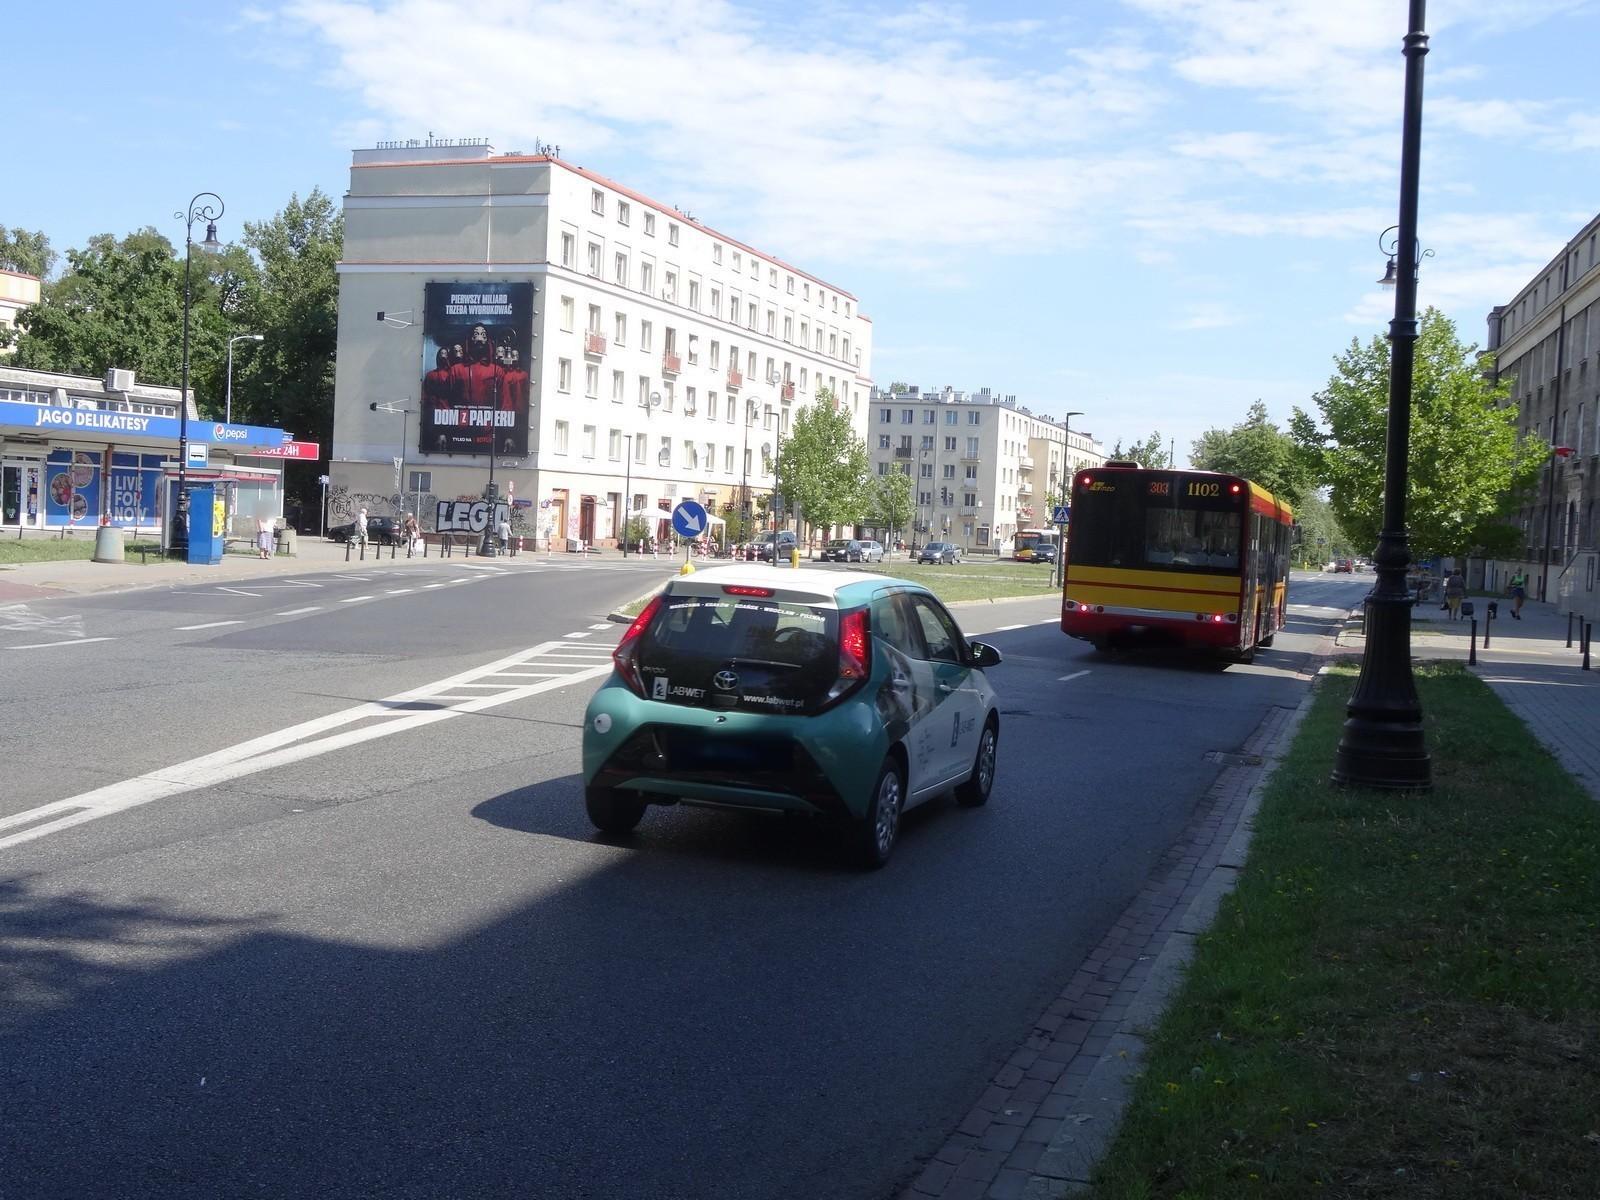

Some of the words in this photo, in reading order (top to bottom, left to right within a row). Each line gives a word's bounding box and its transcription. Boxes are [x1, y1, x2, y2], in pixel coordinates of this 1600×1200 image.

[451, 294, 481, 304] PIERWSZY
[482, 294, 508, 304] MILIARD
[446, 305, 468, 315] TRZEBA
[36, 408, 73, 426] JAGO
[75, 412, 150, 431] DELIKATESY
[434, 409, 459, 426] DOM
[461, 412, 467, 423] Z
[469, 410, 515, 427] PAPIERU
[225, 428, 248, 440] pepsi
[283, 443, 299, 456] 24H
[115, 475, 143, 491] LIVE
[1150, 482, 1169, 494] 303
[1187, 483, 1220, 497] 1102
